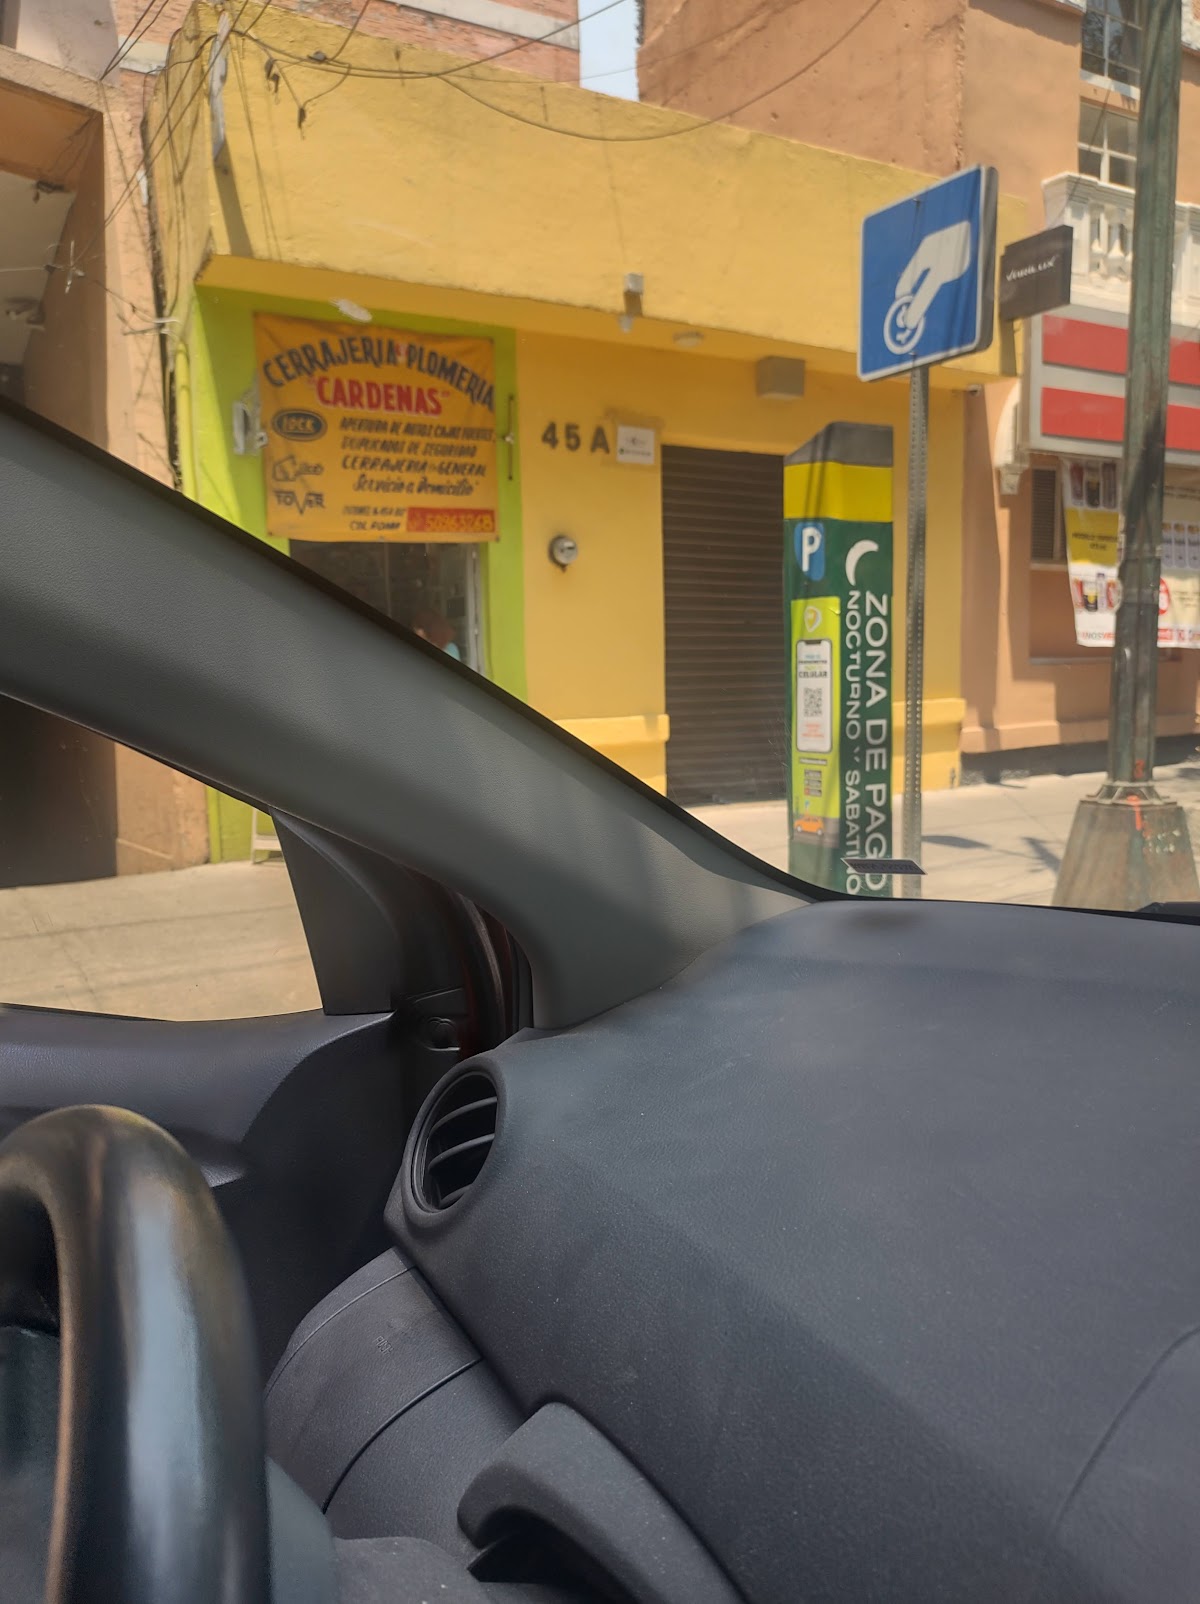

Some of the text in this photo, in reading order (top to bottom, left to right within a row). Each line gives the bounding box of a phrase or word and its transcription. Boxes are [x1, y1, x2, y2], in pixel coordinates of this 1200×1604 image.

[262, 335, 495, 413] CERRAJERIA PLOMERIA
[341, 454, 428, 475] CERRAJERIA
[437, 461, 487, 476] GENERAL
[802, 527, 822, 572] P
[845, 590, 861, 740] NOCTURNO
[865, 590, 888, 891] ZONA DE PAGO
